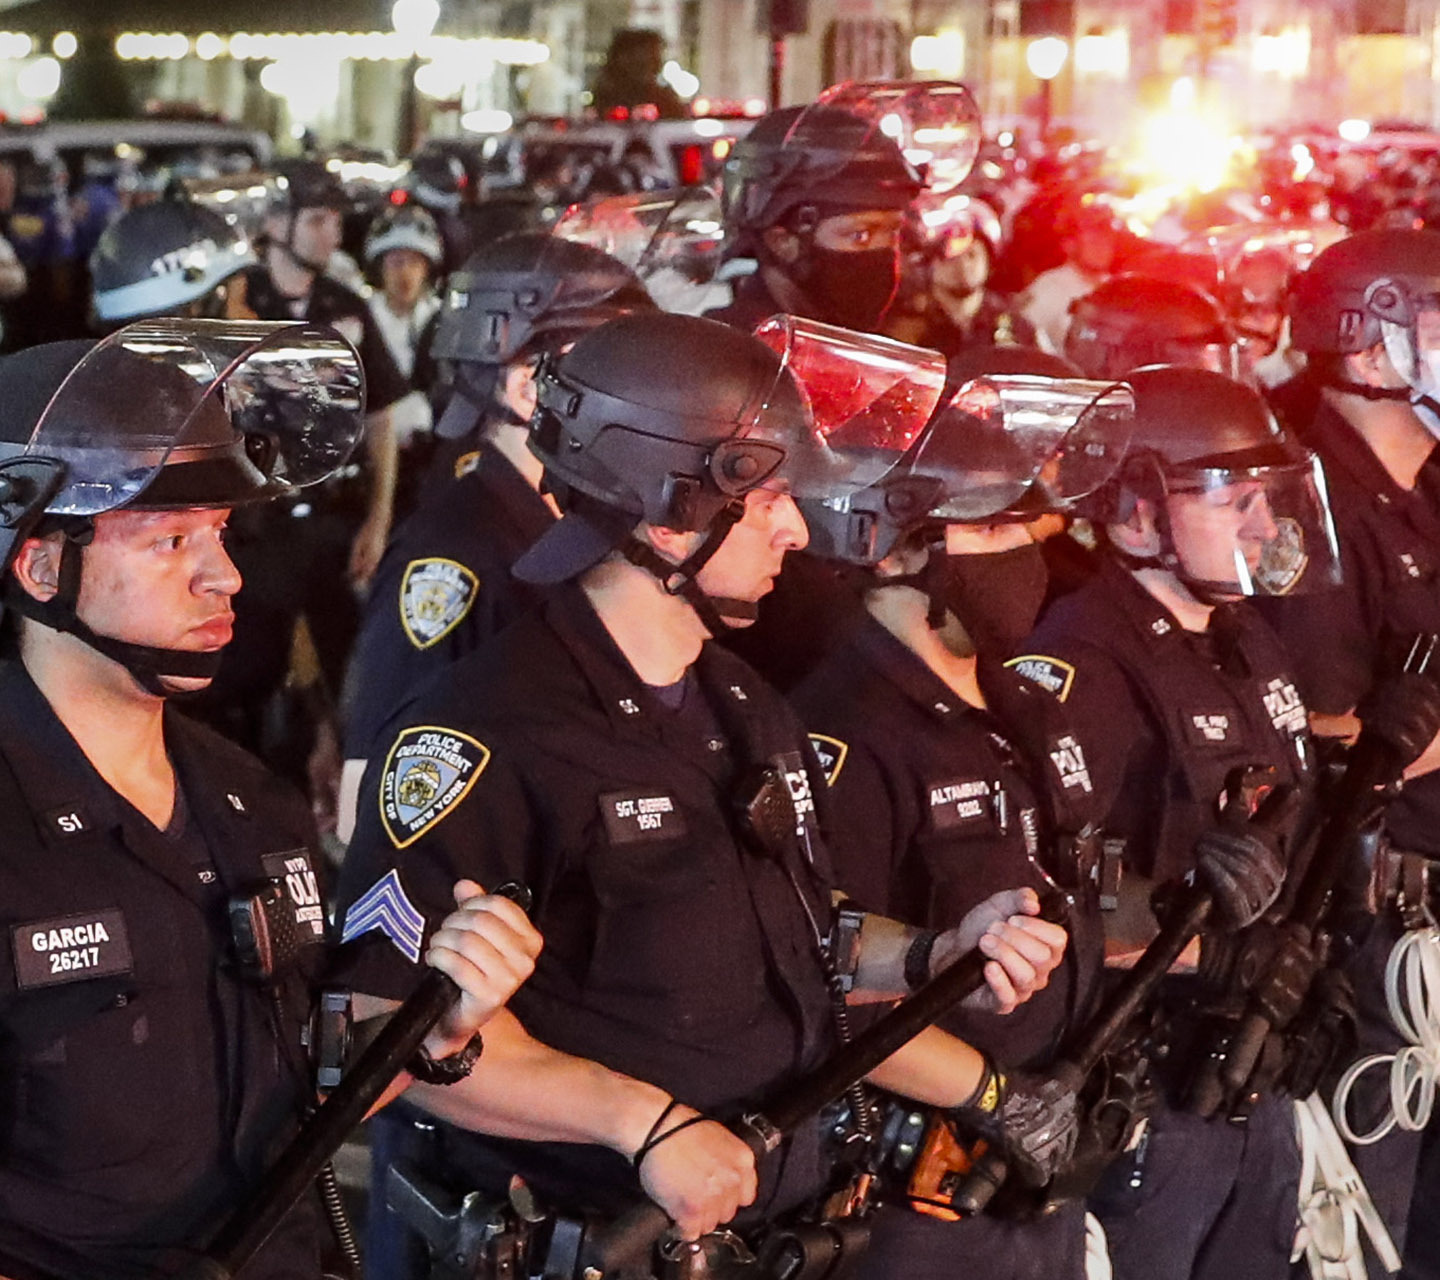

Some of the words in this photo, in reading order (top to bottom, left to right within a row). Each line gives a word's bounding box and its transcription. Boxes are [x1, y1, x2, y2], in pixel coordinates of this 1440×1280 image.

[418, 733, 463, 753] POLICE
[396, 745, 472, 773] DEPARTMENT
[385, 771, 394, 800] CITY
[386, 803, 397, 820] OF
[410, 808, 435, 831] NEW
[434, 779, 466, 810] YORK
[615, 801, 638, 817] SGT.
[58, 814, 83, 832] S1
[32, 922, 109, 952] GARCIA
[49, 947, 100, 974] 26217
